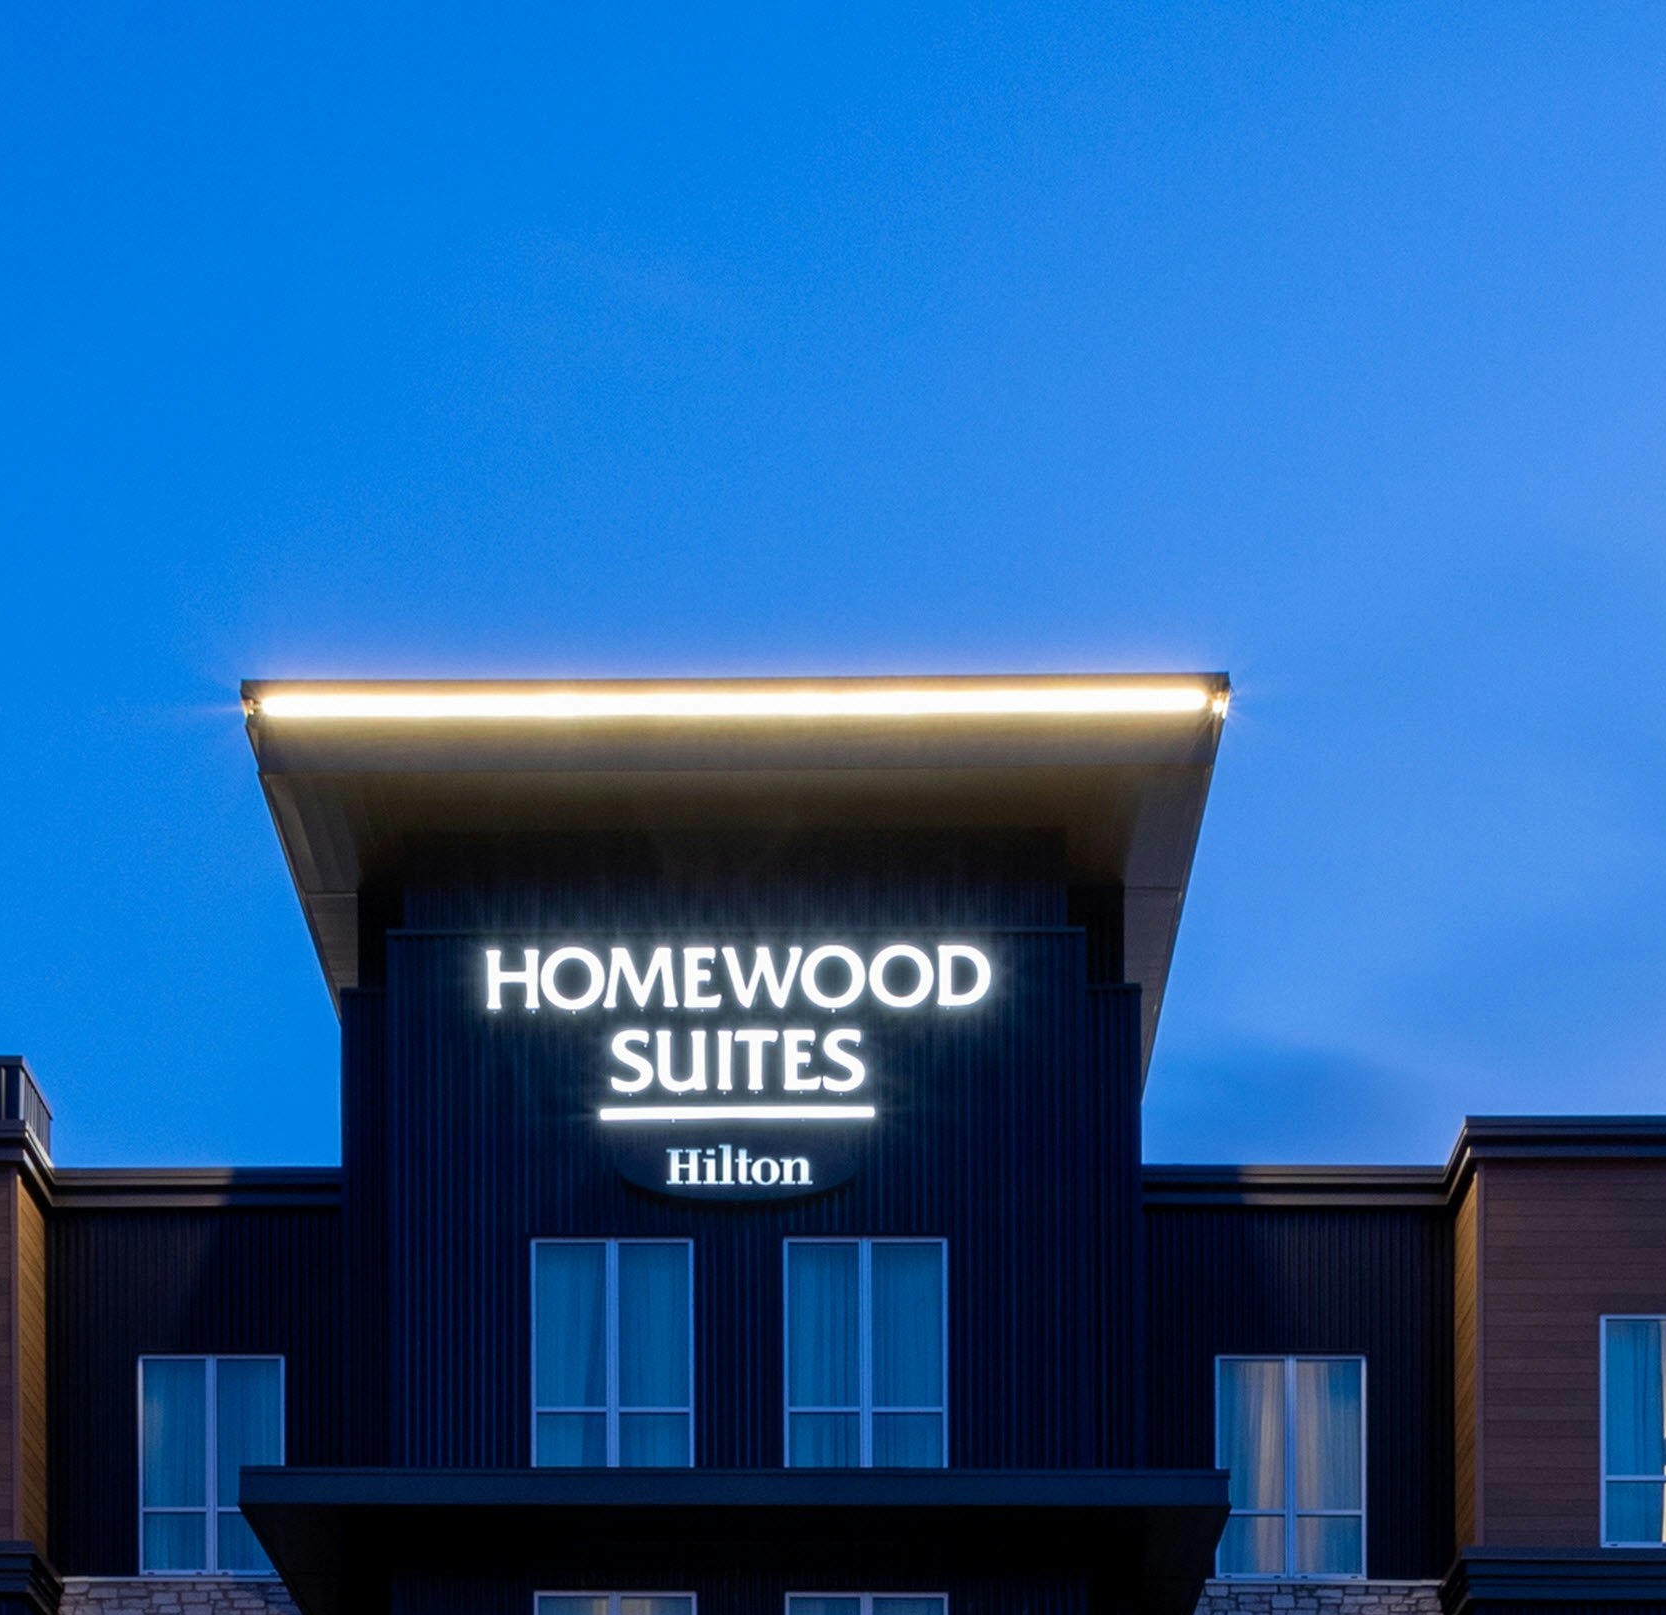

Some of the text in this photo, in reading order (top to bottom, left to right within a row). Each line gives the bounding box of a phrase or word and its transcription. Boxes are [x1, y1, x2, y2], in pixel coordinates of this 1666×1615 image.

[485, 944, 992, 1011] HOMEWOOD
[610, 1028, 866, 1093] SUITES
[666, 1144, 814, 1185] Hilton
